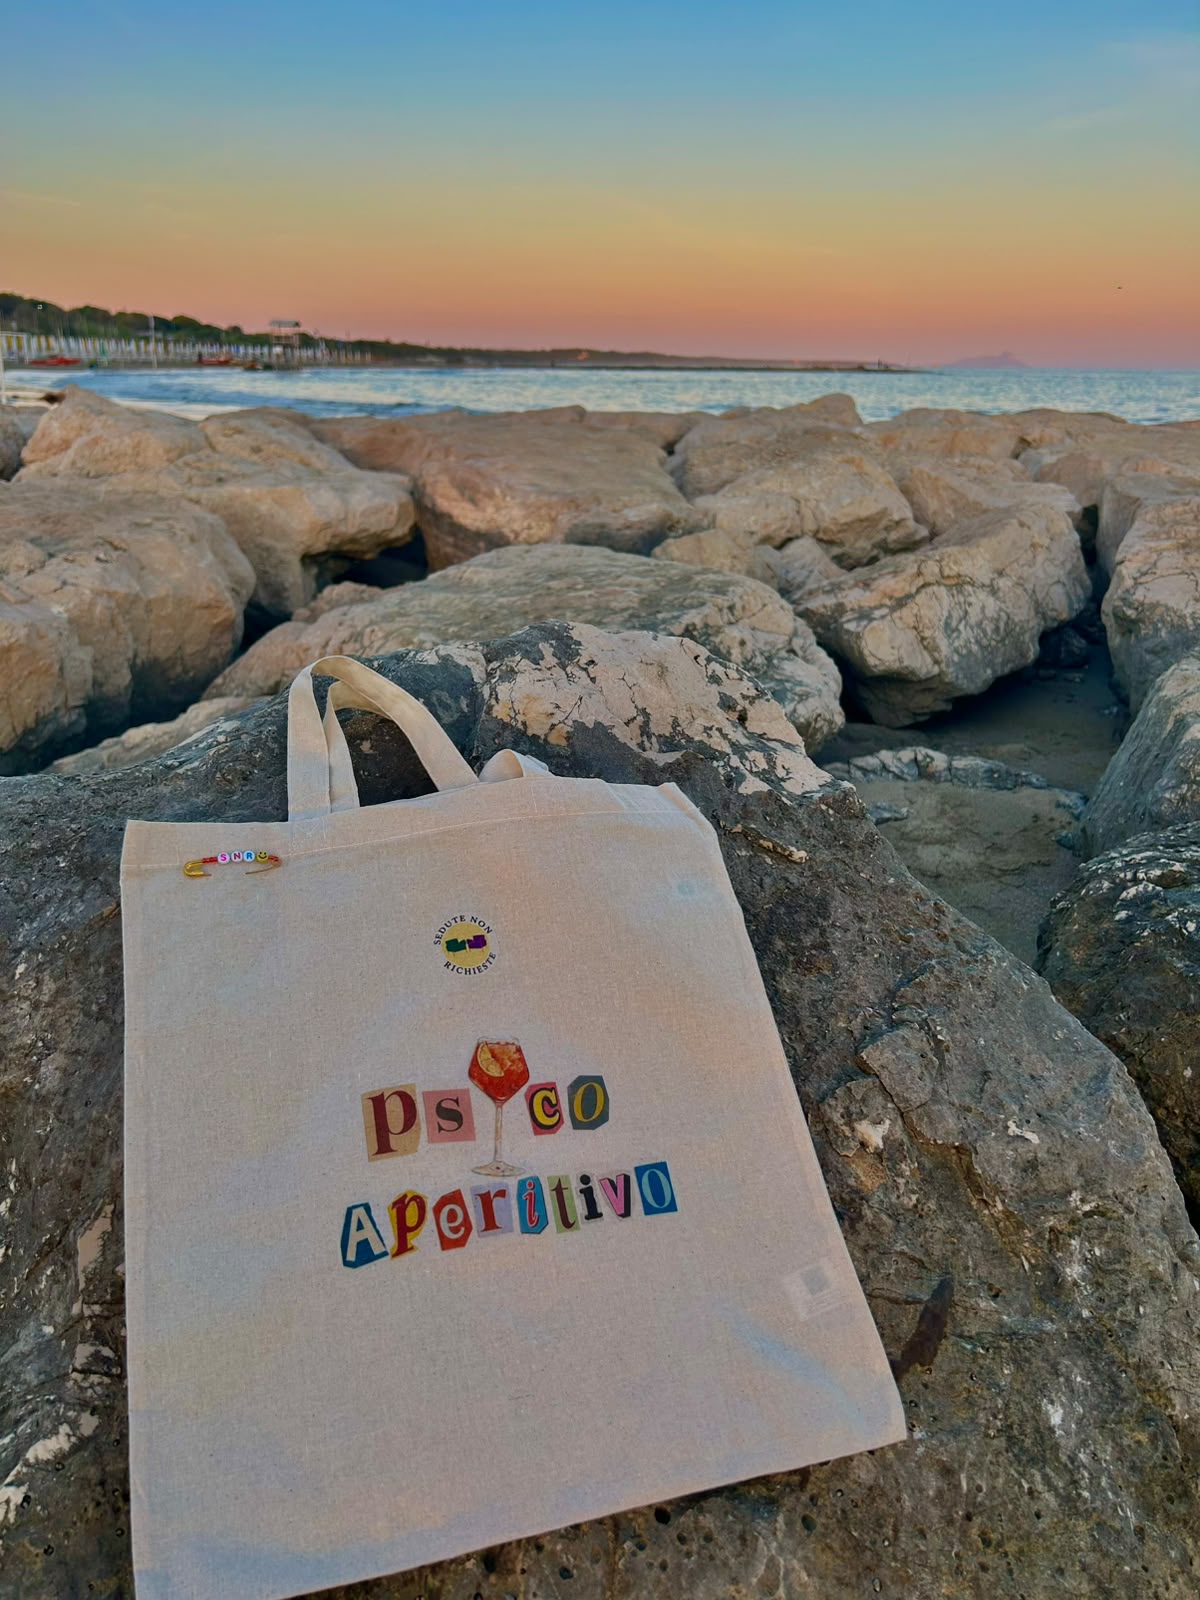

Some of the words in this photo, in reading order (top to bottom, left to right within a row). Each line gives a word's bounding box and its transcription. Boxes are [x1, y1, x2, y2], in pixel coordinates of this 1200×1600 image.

[433, 914, 467, 946] SEDUTE
[469, 915, 493, 934] NON
[443, 951, 497, 976] RICHIESTE
[345, 1168, 672, 1261] Aperitivo
